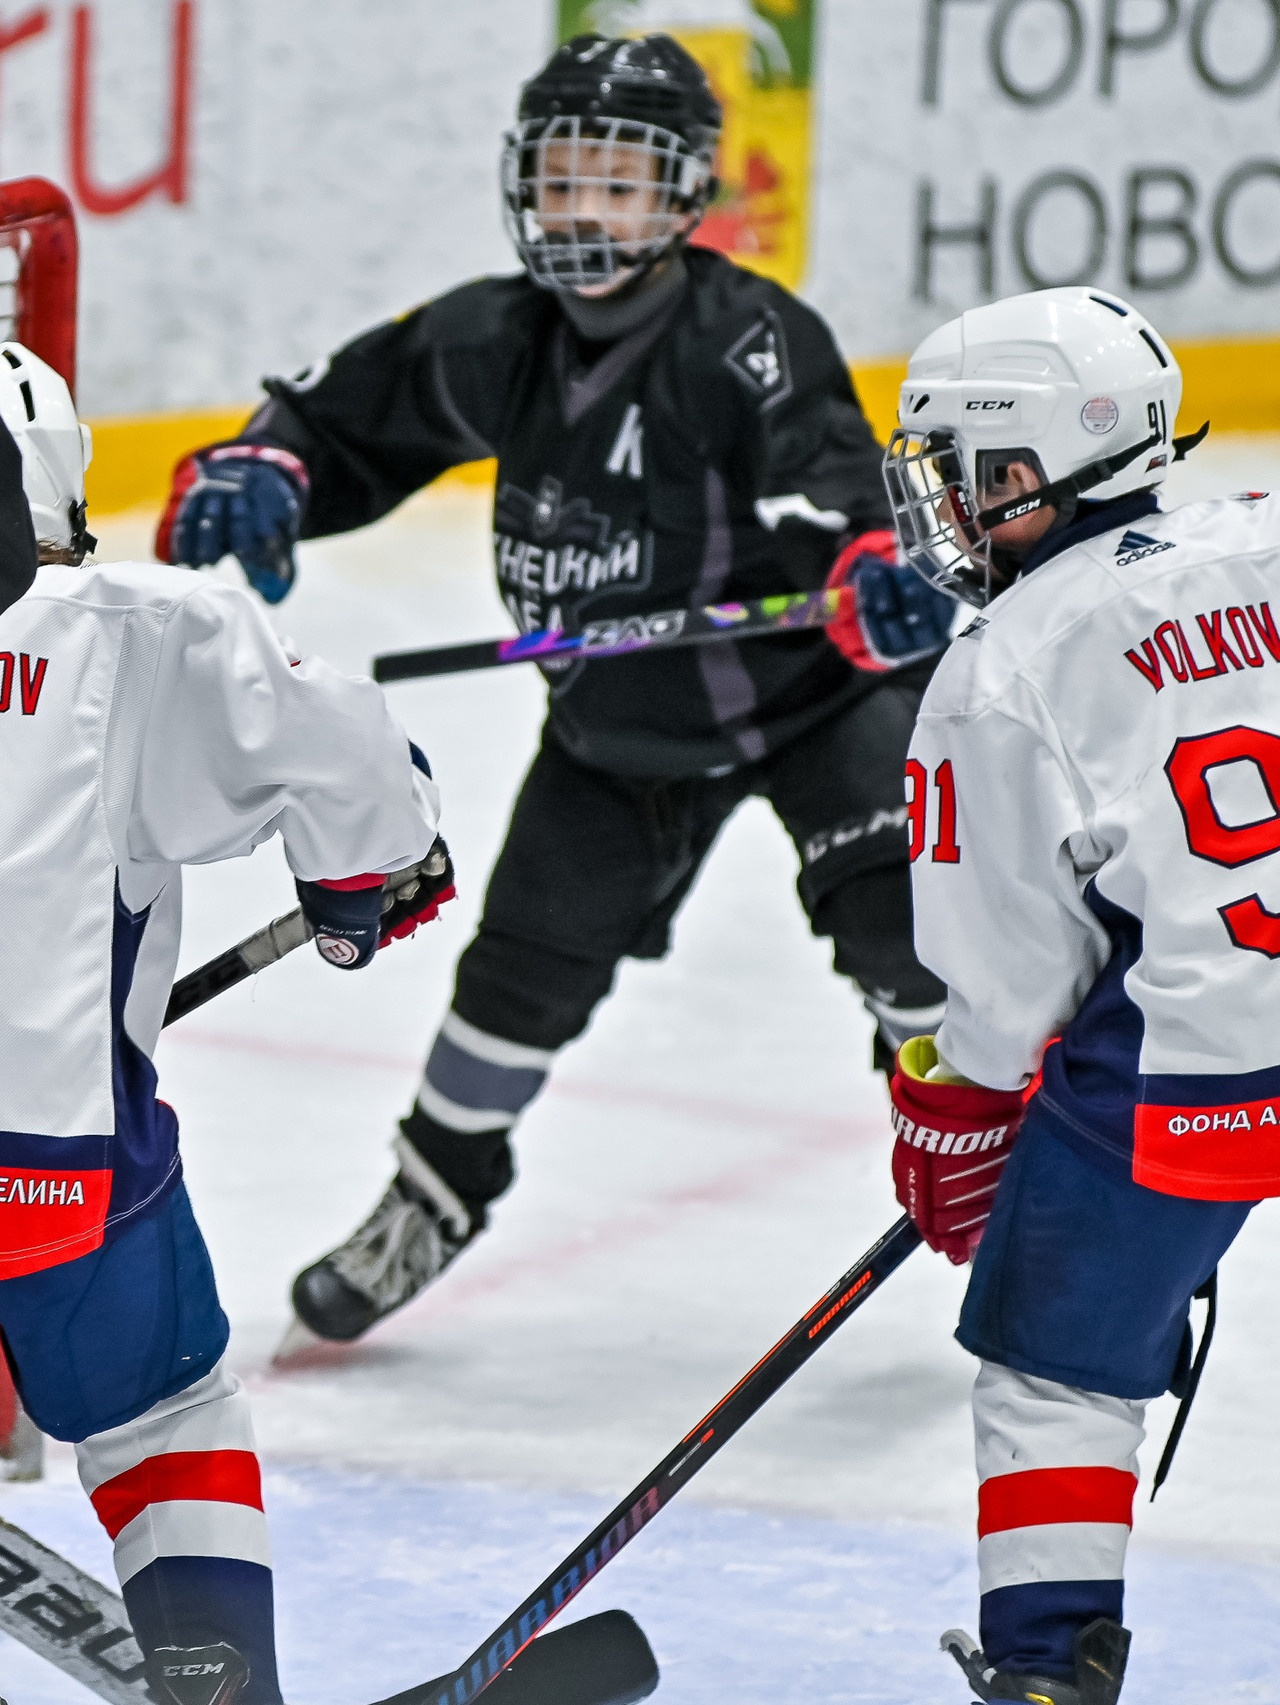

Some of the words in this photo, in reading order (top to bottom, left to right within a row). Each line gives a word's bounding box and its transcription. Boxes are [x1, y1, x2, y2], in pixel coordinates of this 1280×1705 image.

[965, 400, 1015, 411] CCM
[1147, 399, 1167, 445] 91
[1003, 499, 1041, 521] CCM
[1116, 542, 1177, 567] adidas
[1125, 601, 1280, 694] VOLKOV
[1167, 1113, 1252, 1137] ФОНД
[808, 1270, 872, 1339] WARRIOR
[162, 1661, 226, 1678] CCM
